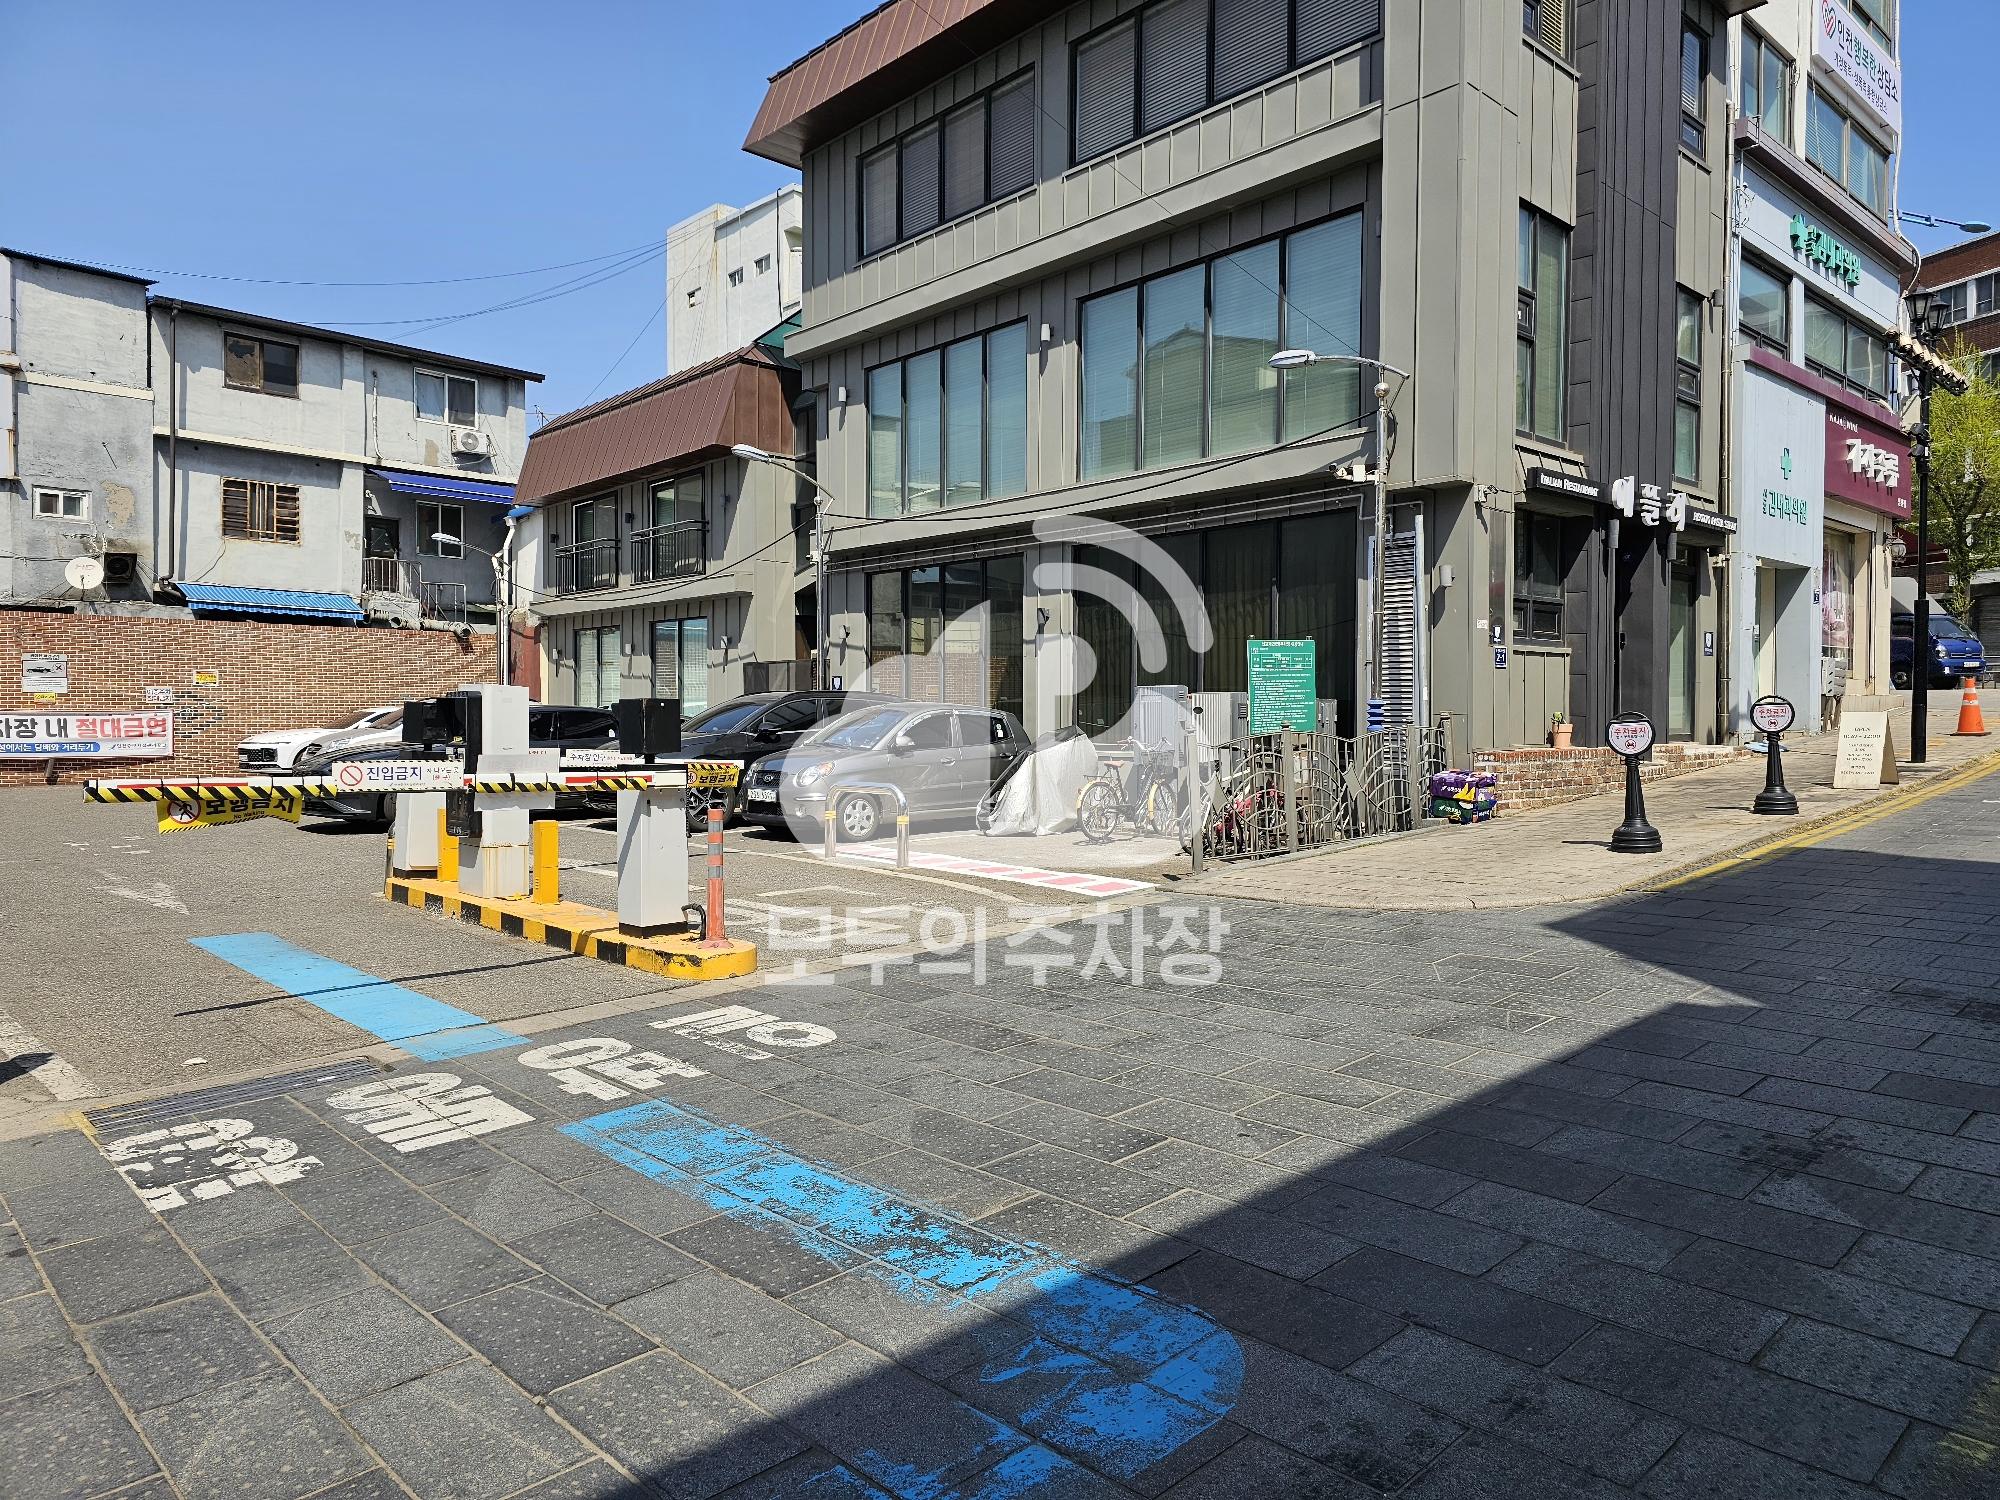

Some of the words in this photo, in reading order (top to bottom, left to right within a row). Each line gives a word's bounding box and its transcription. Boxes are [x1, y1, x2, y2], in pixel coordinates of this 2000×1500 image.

[45, 717, 69, 739] 내
[75, 717, 167, 739] 절대금연
[61, 743, 94, 752] 거리두기
[366, 766, 422, 781] 진입금지
